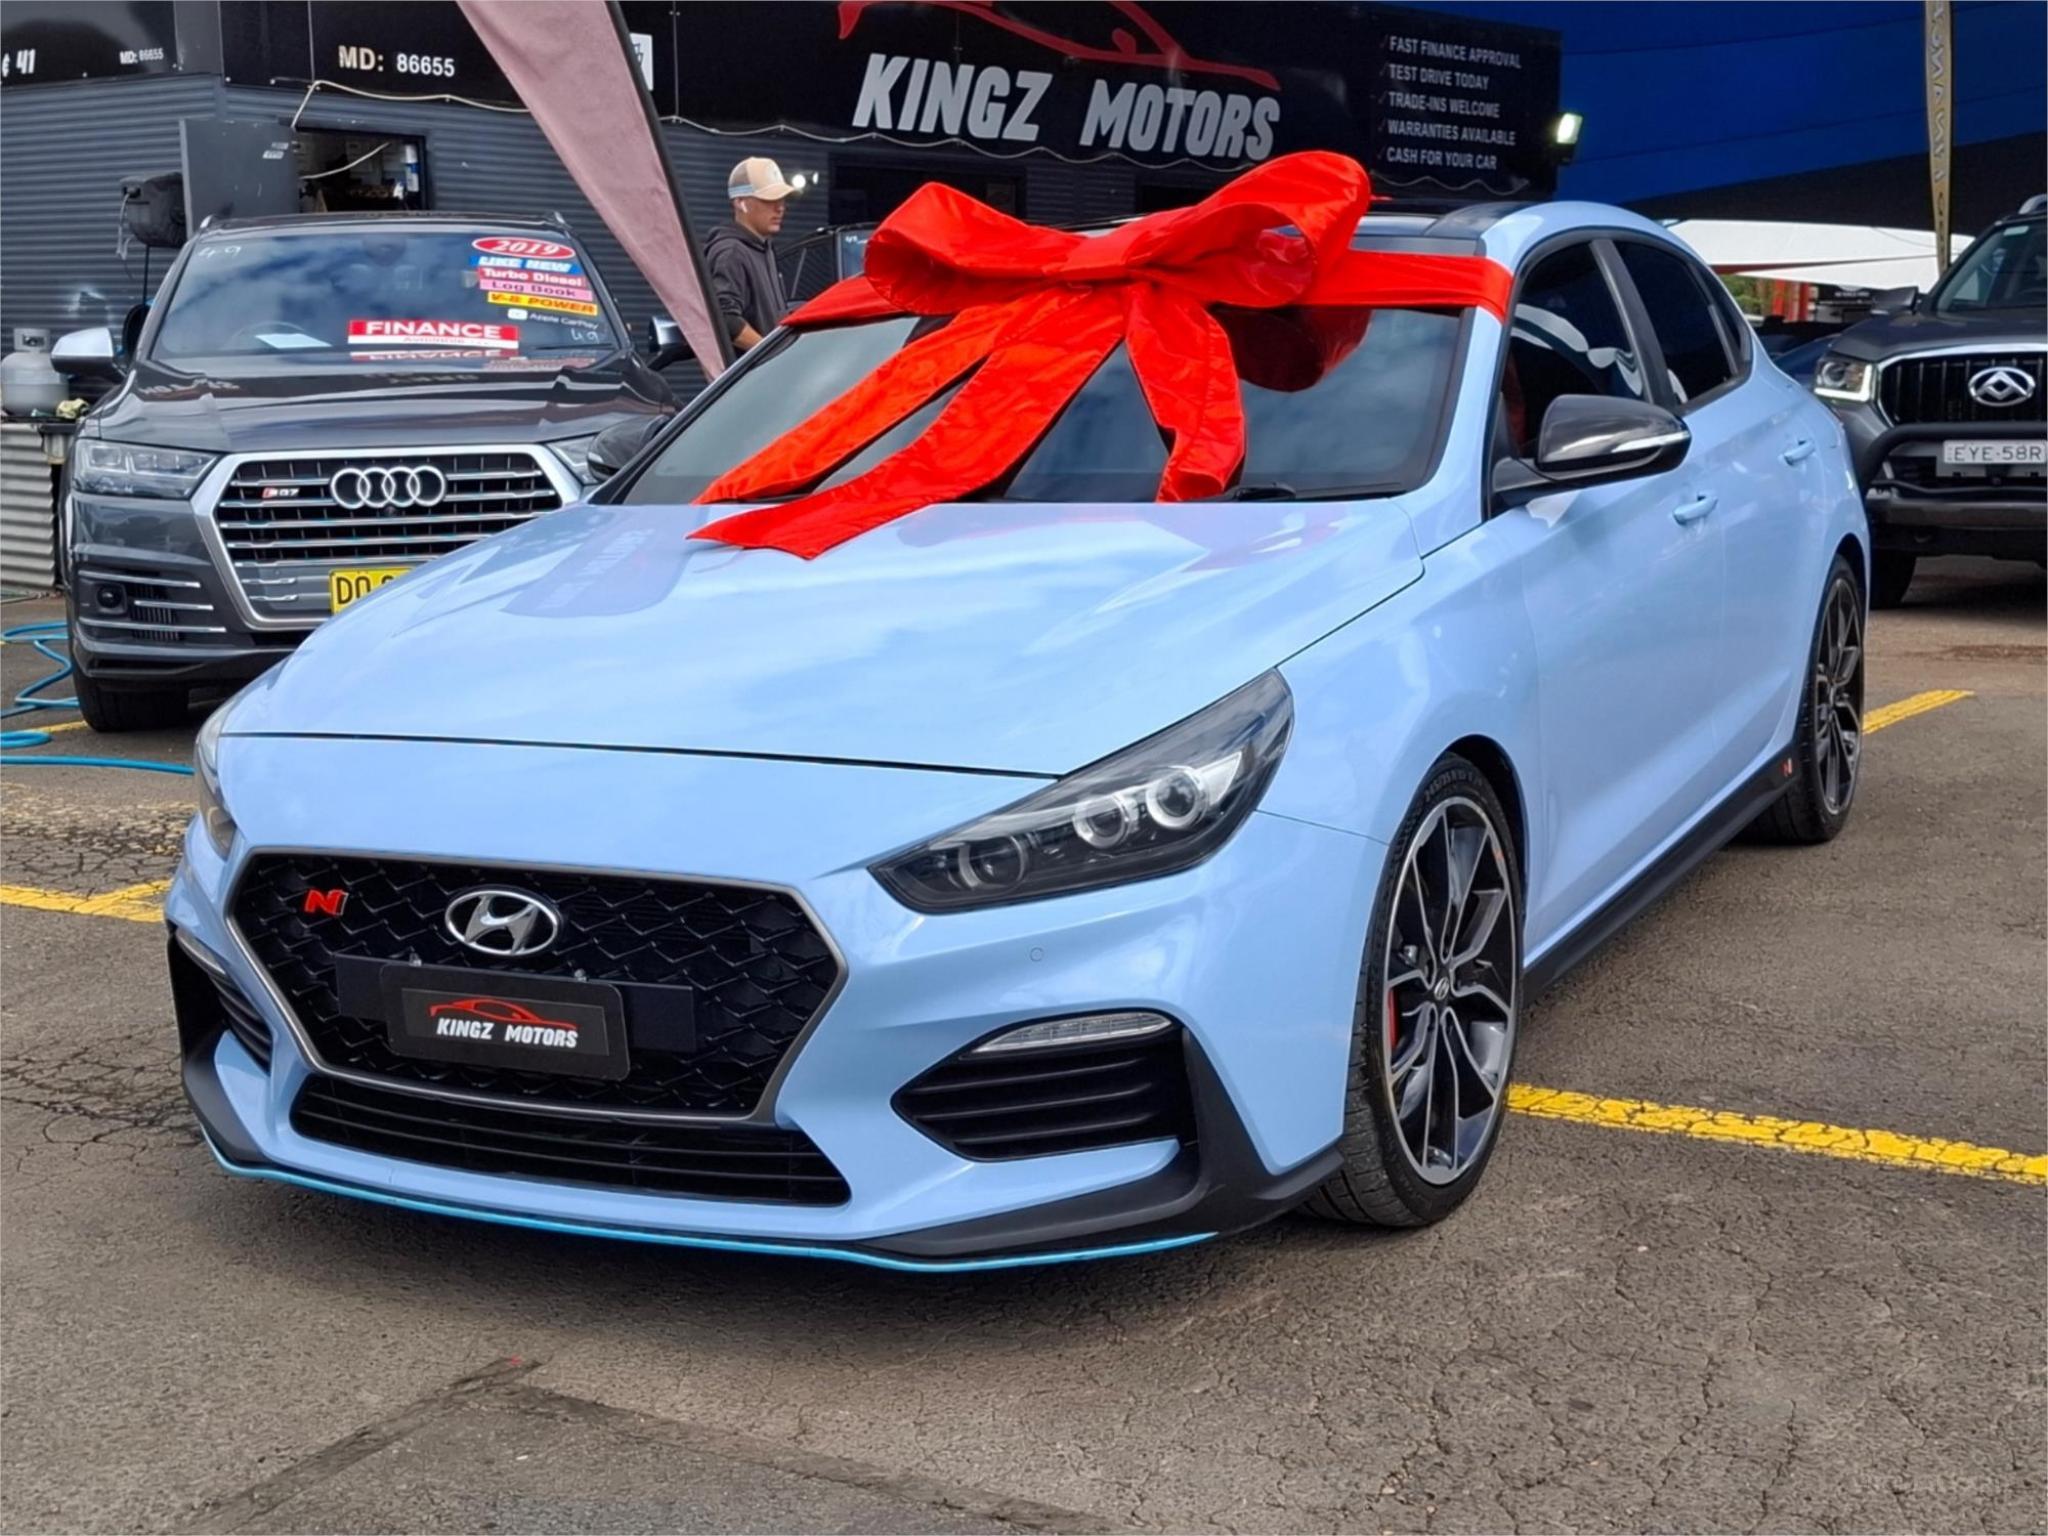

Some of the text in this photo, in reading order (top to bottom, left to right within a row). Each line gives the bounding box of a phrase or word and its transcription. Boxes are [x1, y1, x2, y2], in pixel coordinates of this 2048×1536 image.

[16, 49, 36, 74] 41
[338, 45, 455, 77] MD: 86655
[1389, 36, 1521, 68] FAST FINANCE APPROVAL
[1389, 63, 1489, 90] TEST DRIVE TODAY
[852, 53, 1280, 161] KINGZ MOTORS
[1389, 91, 1500, 118] TRADE-INS WELCOME
[1388, 119, 1516, 146] WARRANTIES AVAILABLE
[1387, 146, 1497, 170] CASH FOR YOUR CAR
[495, 240, 560, 255] 2019
[479, 256, 572, 273] LIKE NEW
[482, 268, 582, 286] Turbo Diesel
[492, 282, 575, 297] Log Book
[528, 297, 595, 313] POWER
[366, 320, 502, 339] FINANCE
[436, 1018, 578, 1049] KINGZ MOTORS
